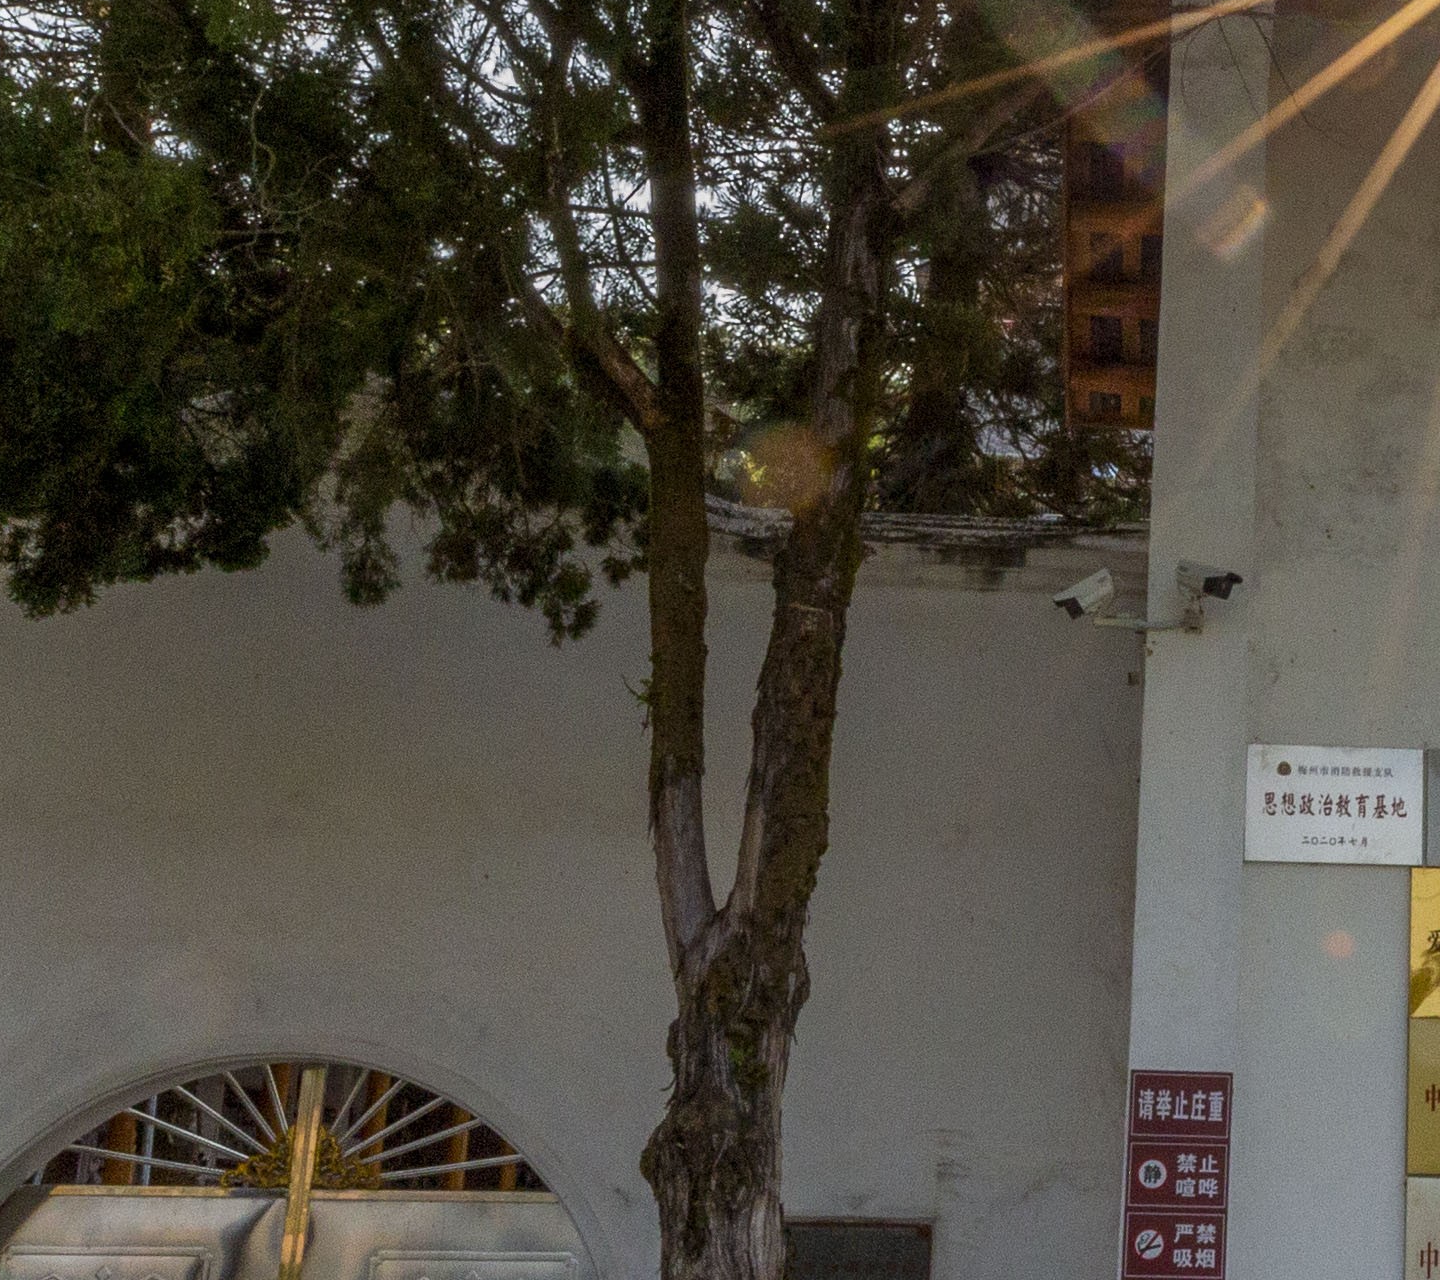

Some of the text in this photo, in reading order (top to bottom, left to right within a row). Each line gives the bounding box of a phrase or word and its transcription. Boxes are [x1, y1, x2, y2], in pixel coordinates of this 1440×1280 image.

[1262, 791, 1408, 820] 思想政治教育基地
[1138, 1088, 1224, 1122] 请举止庄重
[1176, 1153, 1219, 1173] 禁止
[1175, 1177, 1218, 1198] 喧哗
[1173, 1223, 1217, 1244] 严禁
[1172, 1248, 1216, 1269] 吸烟
